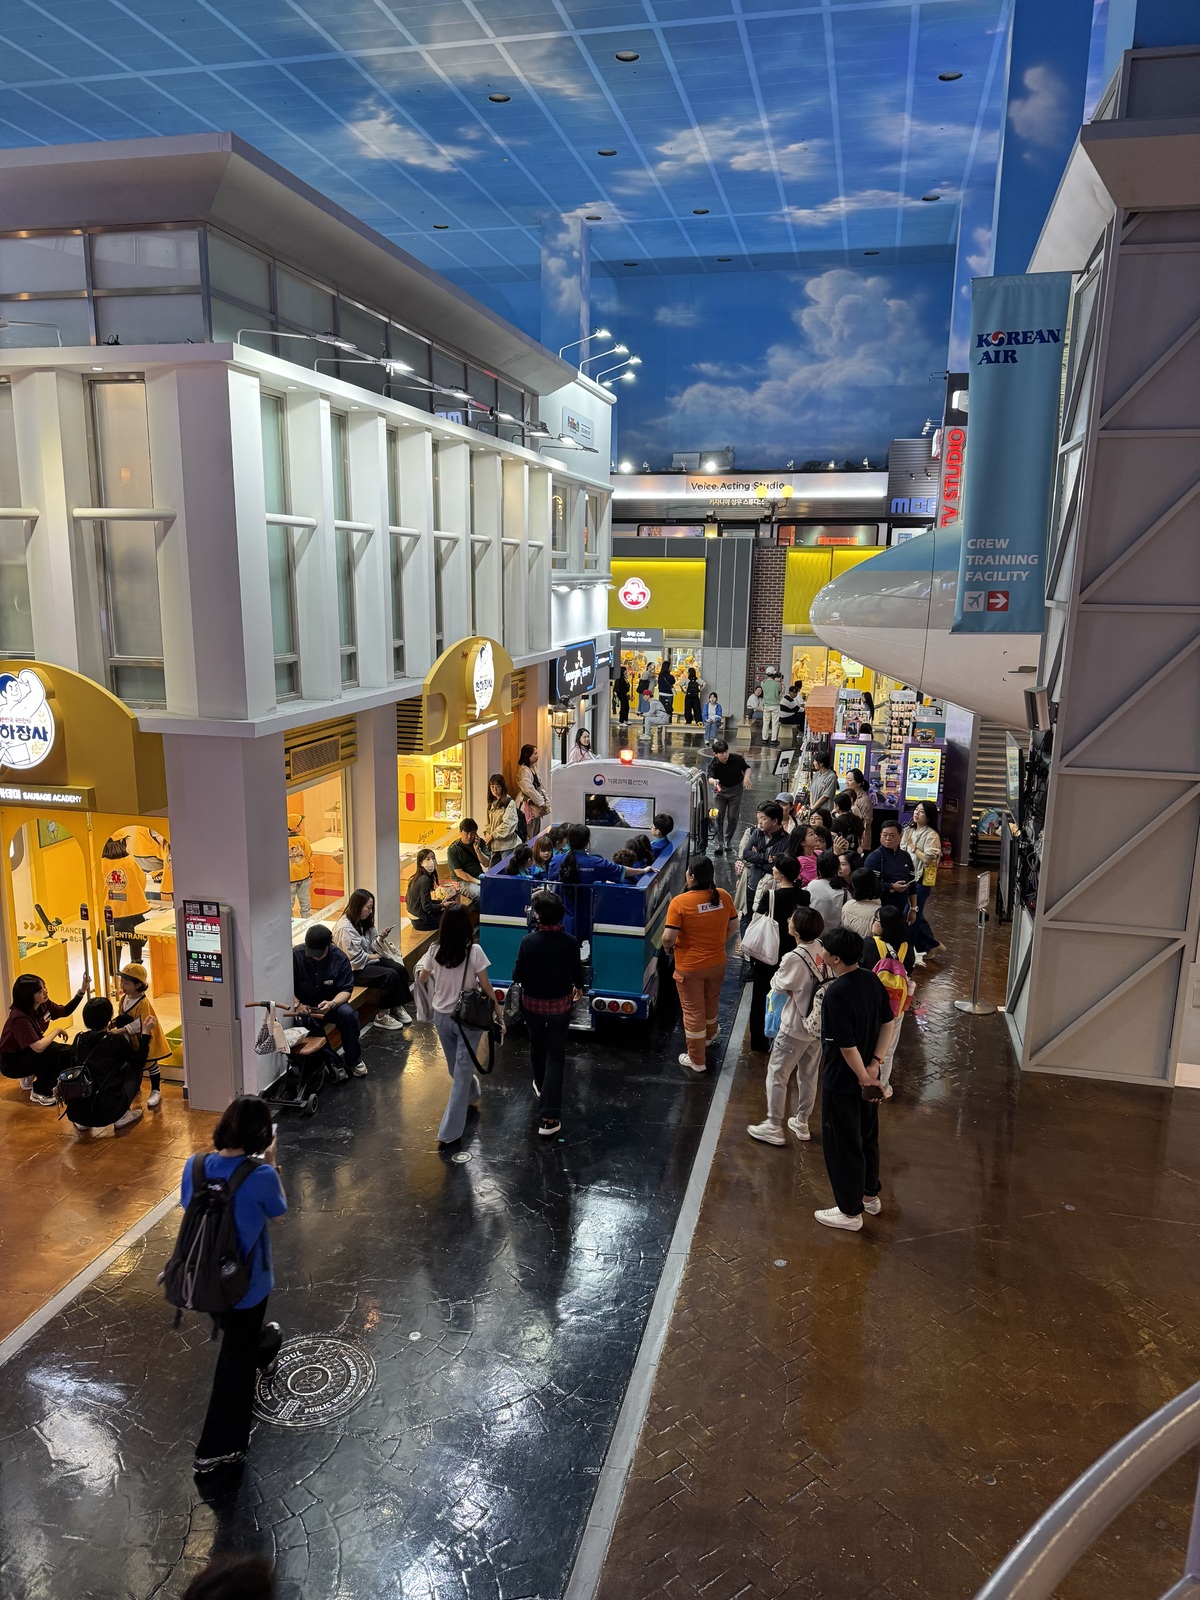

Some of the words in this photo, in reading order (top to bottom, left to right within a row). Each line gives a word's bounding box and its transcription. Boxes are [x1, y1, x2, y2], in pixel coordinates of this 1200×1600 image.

[976, 329, 1061, 348] KOREAN
[977, 349, 1018, 365] AIR
[944, 428, 965, 501] STUDIO
[691, 482, 718, 490] Voice
[720, 481, 750, 491] Acting
[942, 505, 958, 528] TV
[967, 538, 1010, 549] CREW
[965, 554, 1039, 566] TRAINING
[964, 570, 1030, 582] FACILITY
[0, 723, 48, 742] 하장사
[22, 792, 52, 801] SAUSAGE
[53, 794, 82, 803] ACADEMY
[115, 931, 148, 940] ENTRANC
